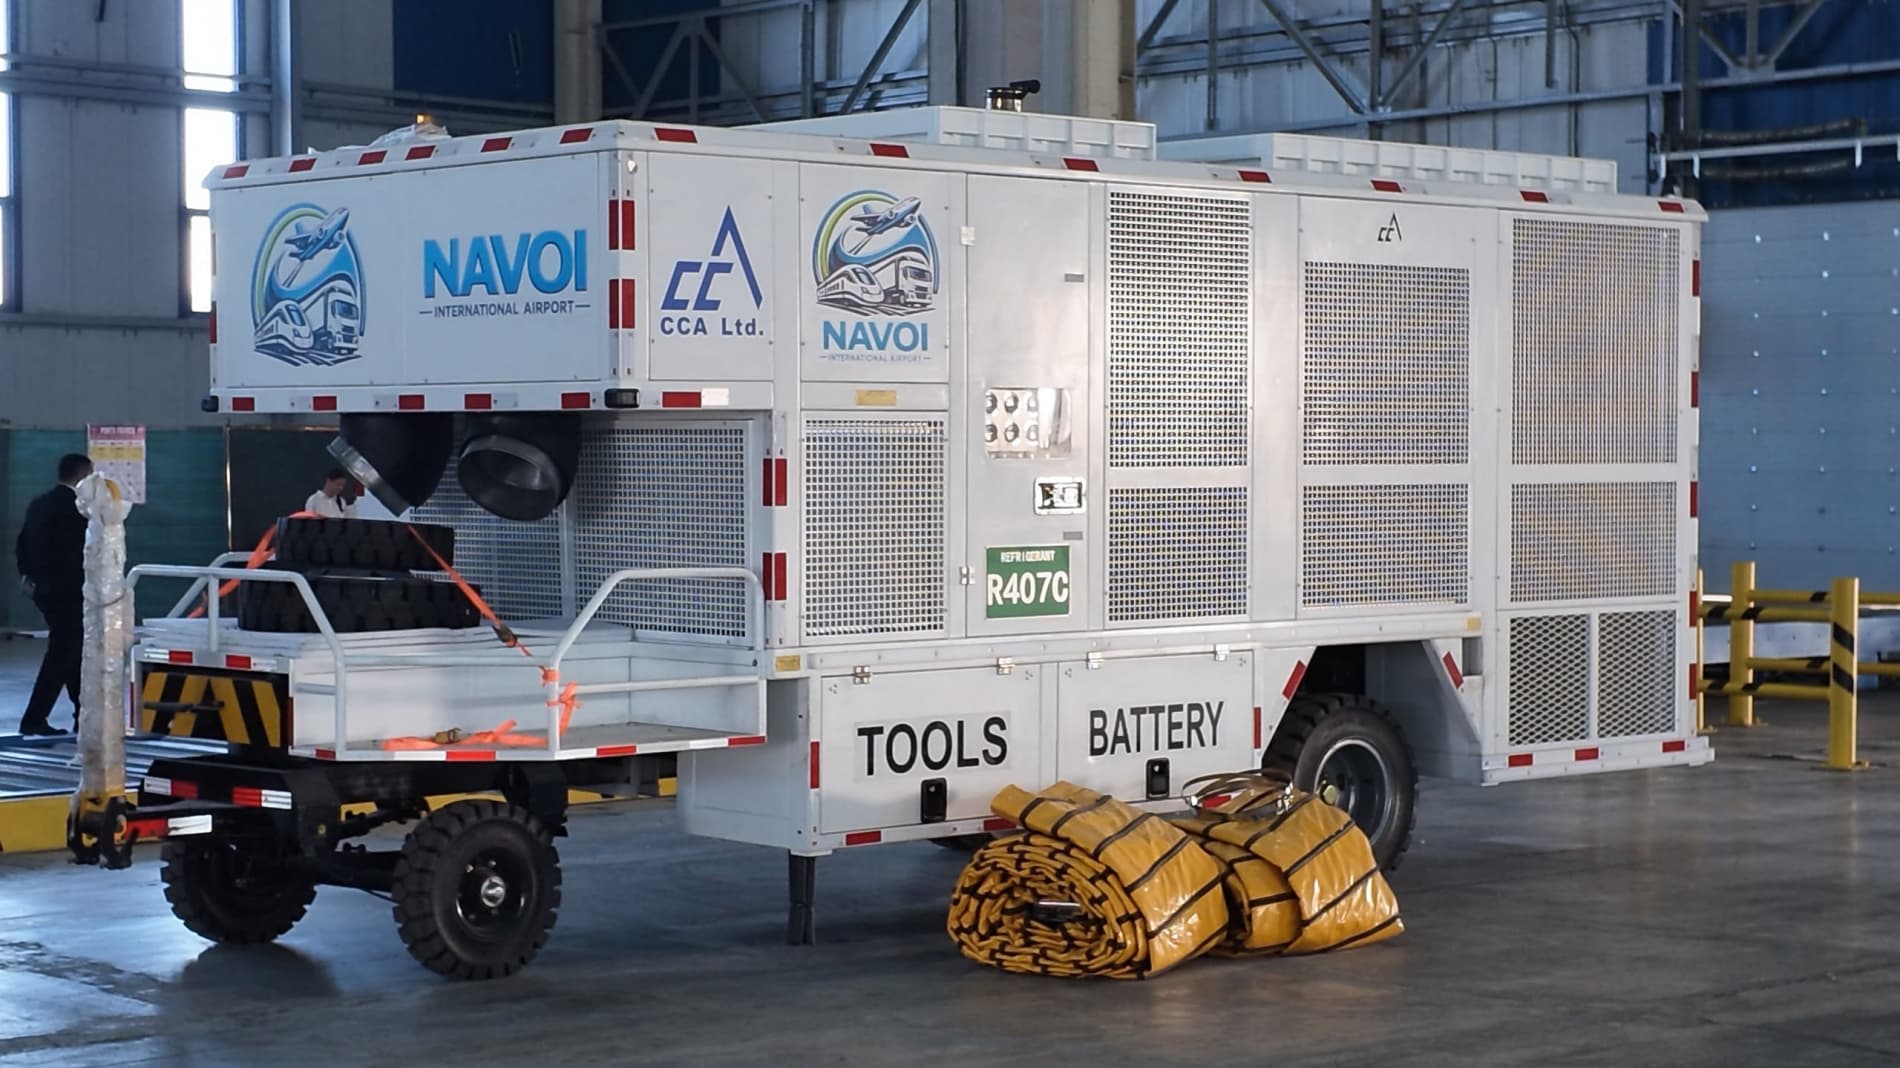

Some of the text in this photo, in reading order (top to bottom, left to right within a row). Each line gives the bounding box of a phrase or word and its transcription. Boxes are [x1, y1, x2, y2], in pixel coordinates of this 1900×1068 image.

[424, 229, 588, 299] NAVOI
[434, 300, 575, 318] INTERNATIONAL AIRPORT
[660, 316, 764, 337] CCA Ltd.
[823, 320, 929, 352] NAVOI
[987, 570, 1069, 606] R407C
[857, 716, 1008, 776] TOOLS
[1089, 701, 1225, 757] BATTERY
